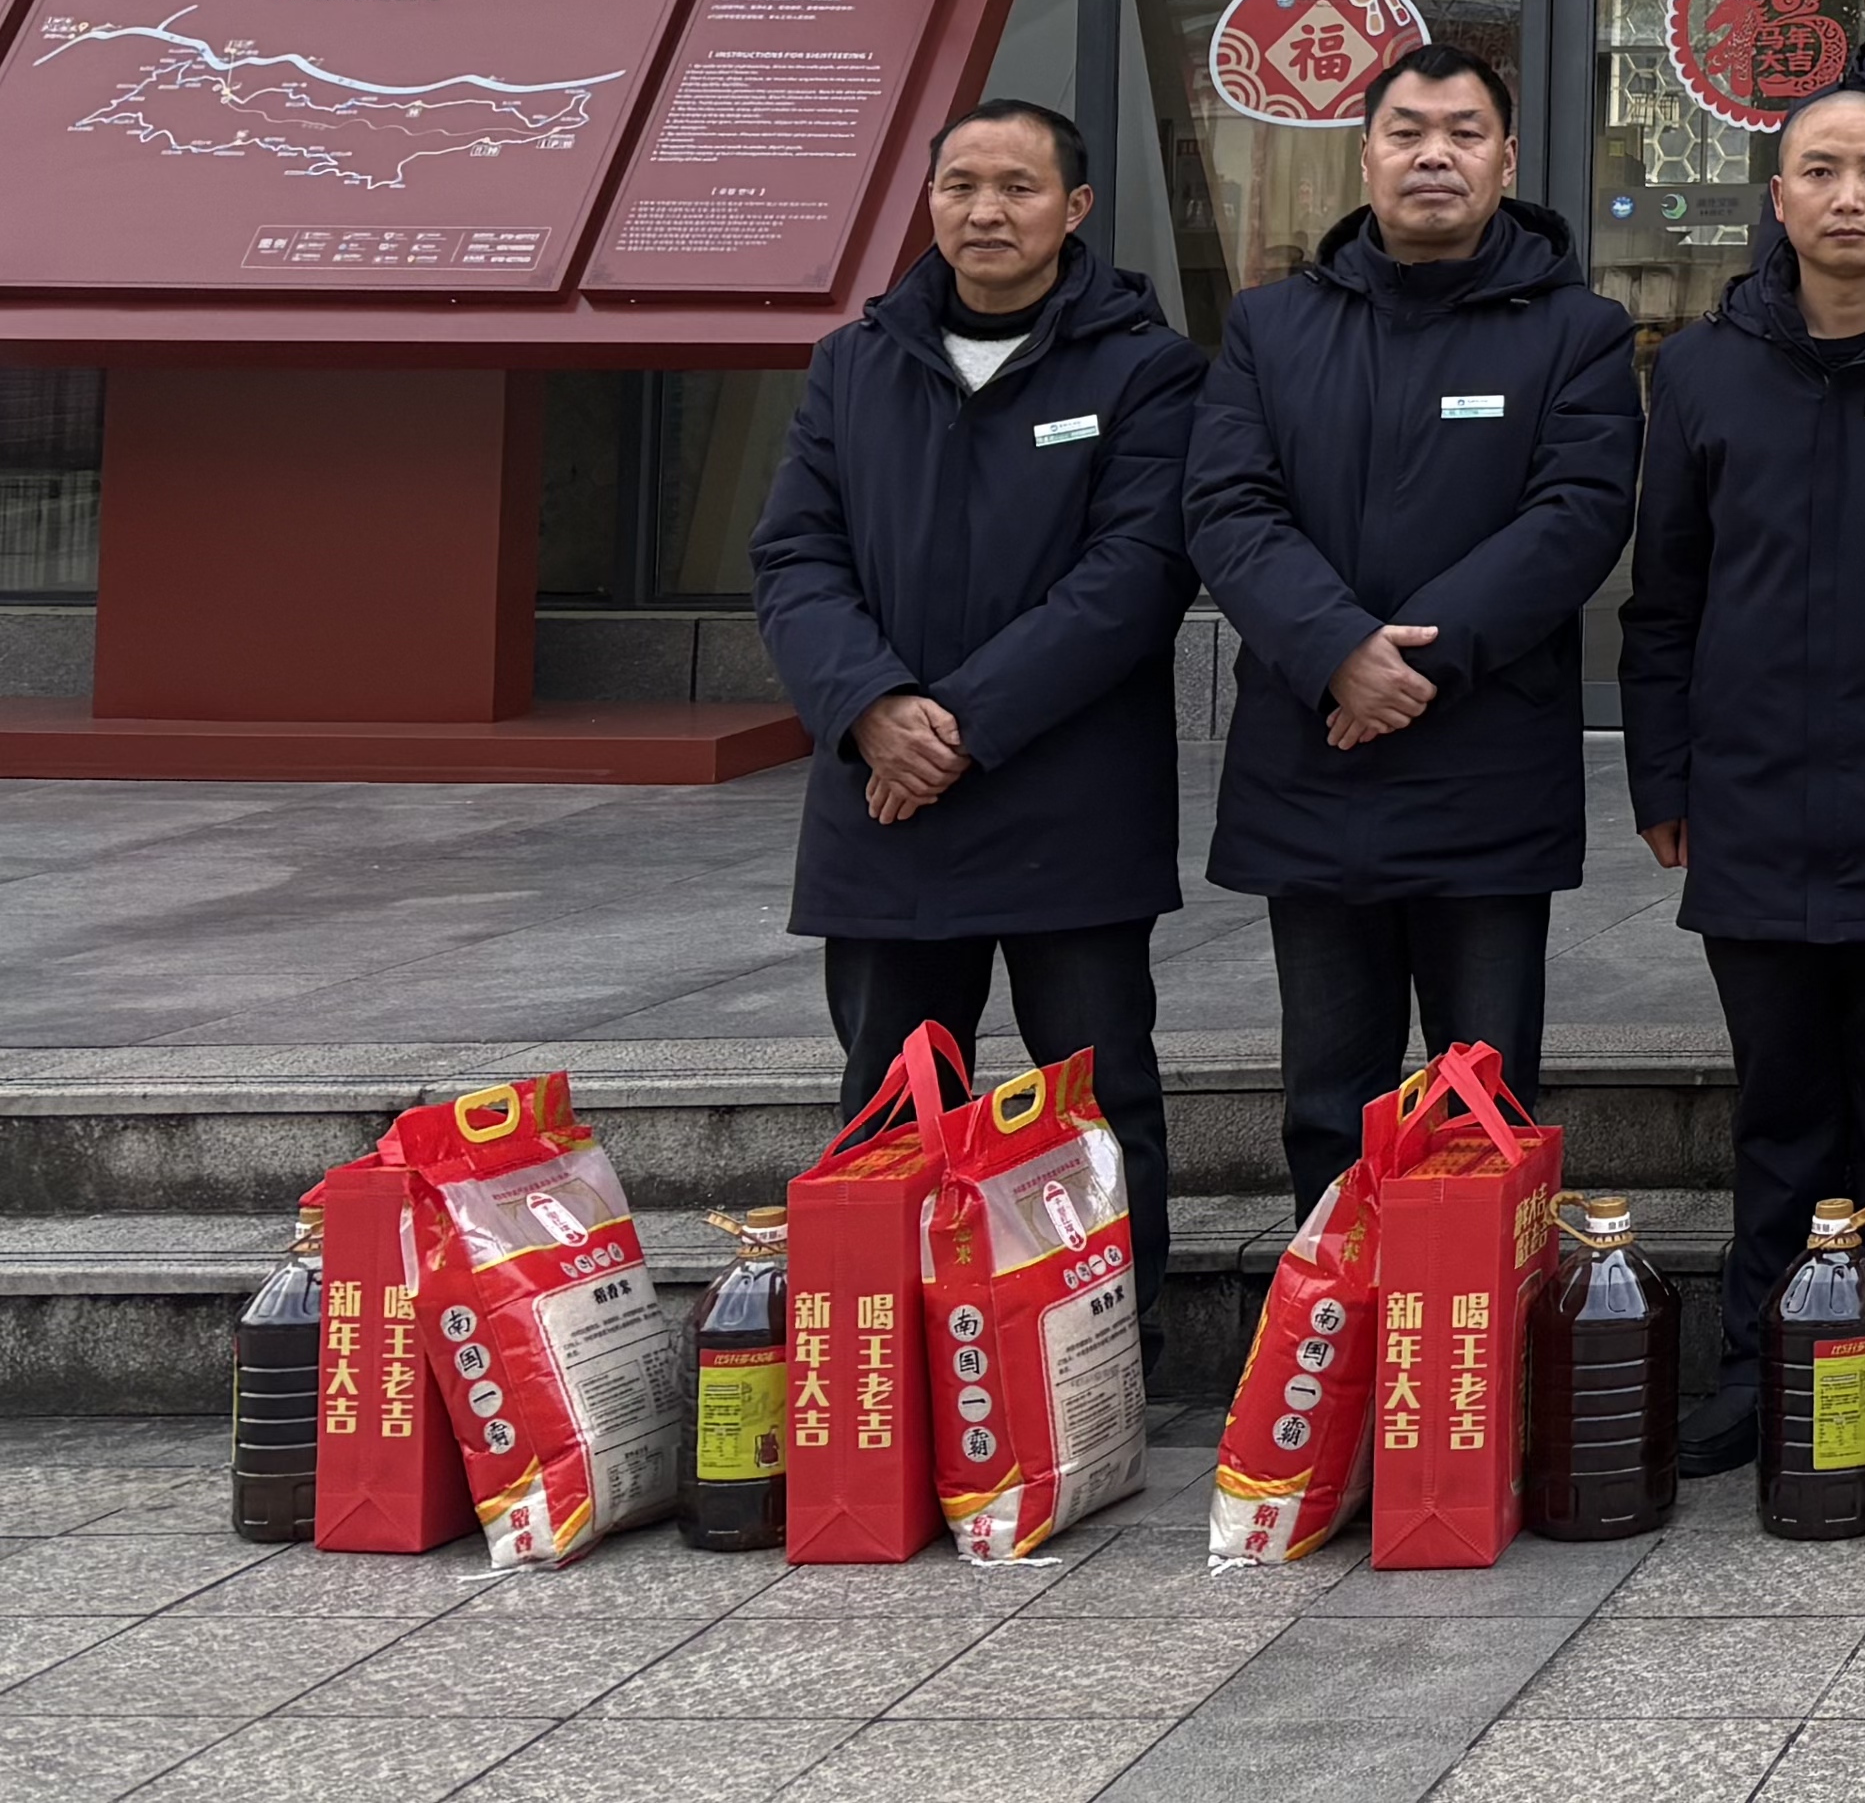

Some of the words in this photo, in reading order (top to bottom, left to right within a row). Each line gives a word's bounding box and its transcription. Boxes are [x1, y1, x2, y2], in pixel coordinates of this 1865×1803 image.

[1288, 24, 1353, 83] 福
[327, 1282, 362, 1434] 新年大吉
[381, 1284, 416, 1437] 喝王老吉
[794, 1293, 830, 1447] 新年大吉
[857, 1294, 894, 1449] 喝王老吉
[953, 1308, 993, 1458] 南国一霸
[1276, 1301, 1341, 1448] 南国一霸
[1384, 1292, 1423, 1450] 新年大吉
[1450, 1292, 1489, 1451] 喝王老吉
[508, 1507, 534, 1555] 稻香
[1243, 1503, 1281, 1565] 稻香
